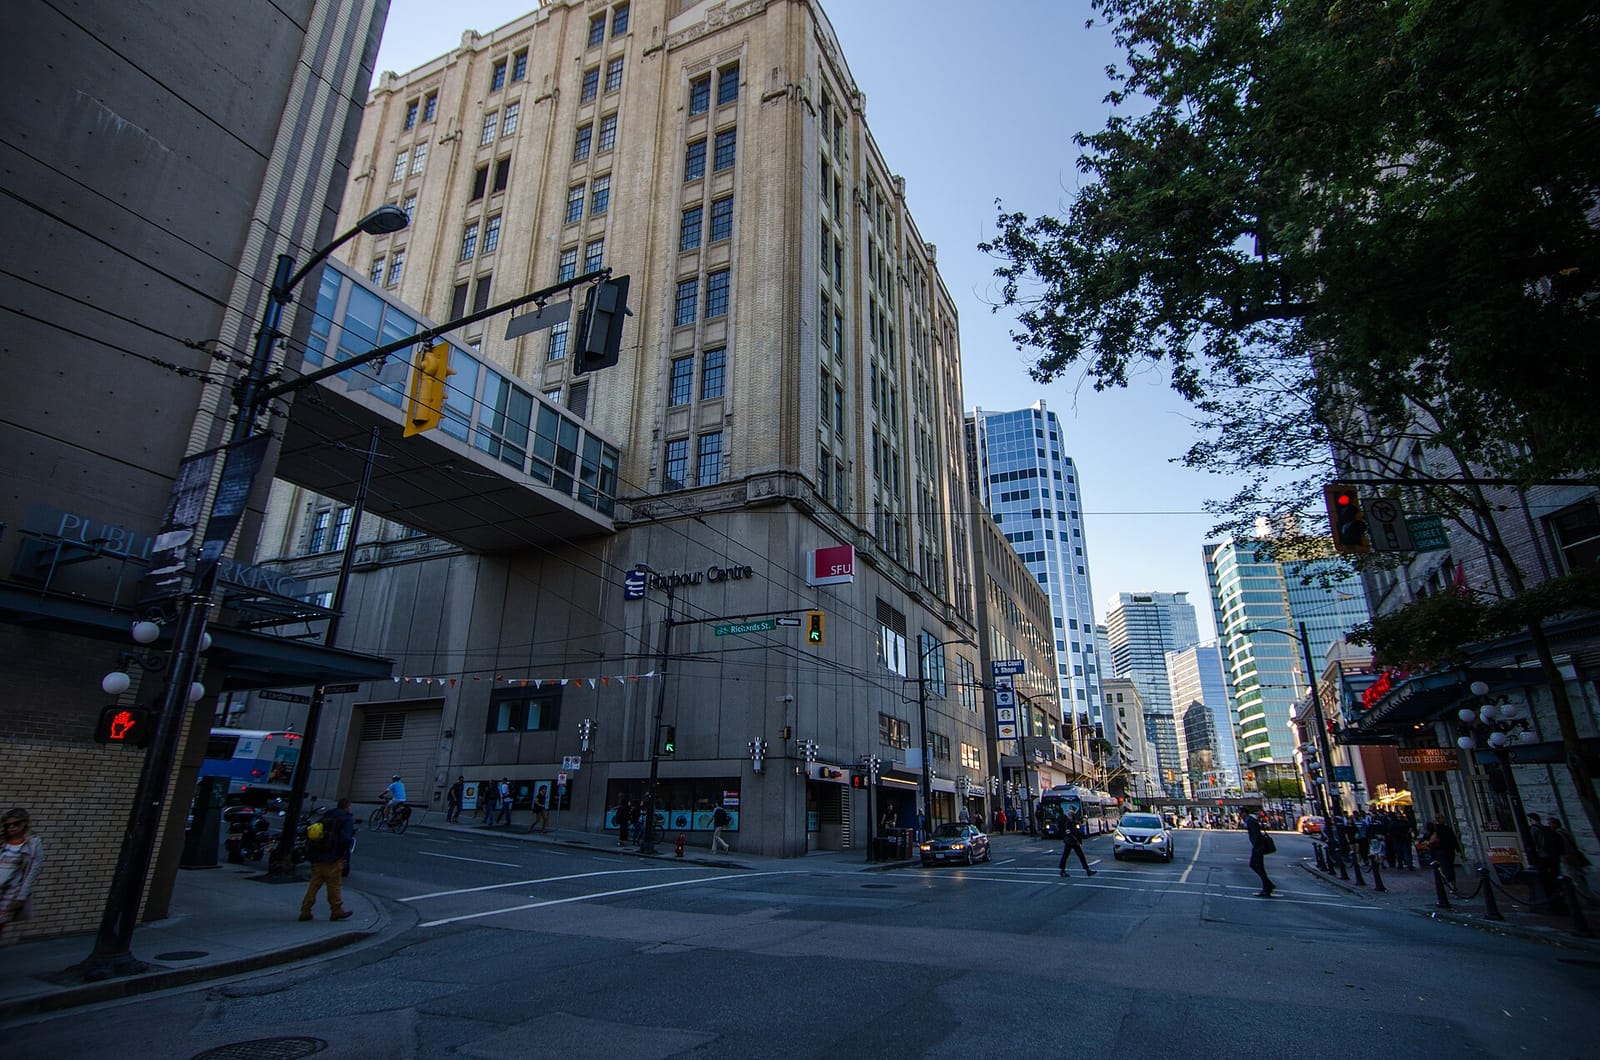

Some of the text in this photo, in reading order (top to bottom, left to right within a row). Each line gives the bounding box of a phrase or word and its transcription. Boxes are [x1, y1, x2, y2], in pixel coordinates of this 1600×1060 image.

[59, 512, 152, 560] PUBLI
[707, 564, 753, 583] Centre
[831, 563, 851, 576] SFU
[730, 623, 760, 634] Richards
[1399, 755, 1447, 764] COLD BEER
